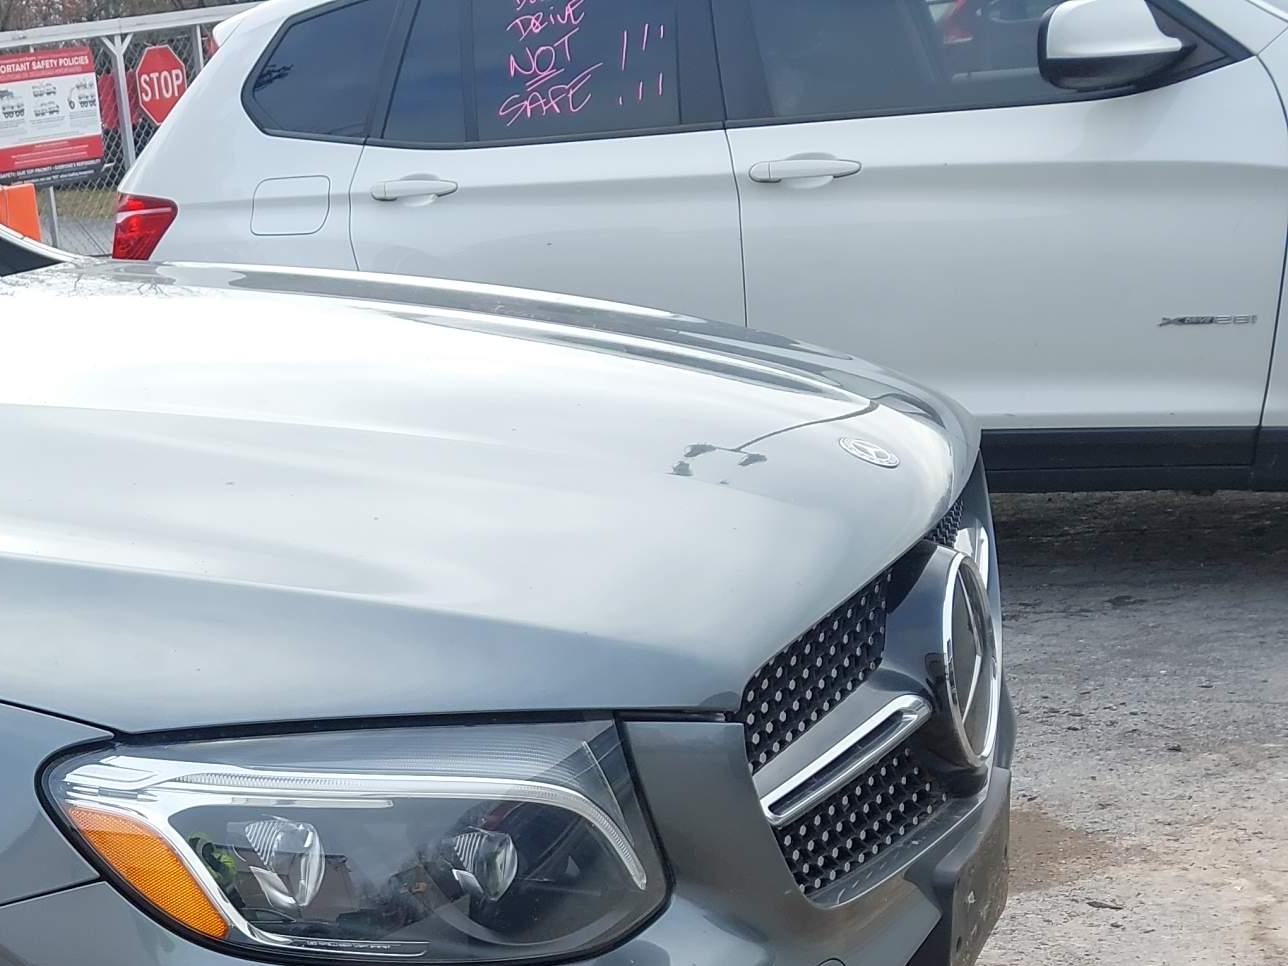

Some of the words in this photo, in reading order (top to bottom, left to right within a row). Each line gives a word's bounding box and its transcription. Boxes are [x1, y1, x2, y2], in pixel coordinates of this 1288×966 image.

[31, 59, 58, 71] SAFETY
[58, 55, 89, 68] POLICIES
[509, 27, 579, 77] NOT
[140, 68, 183, 102] STOP
[498, 62, 603, 126] SAFE
